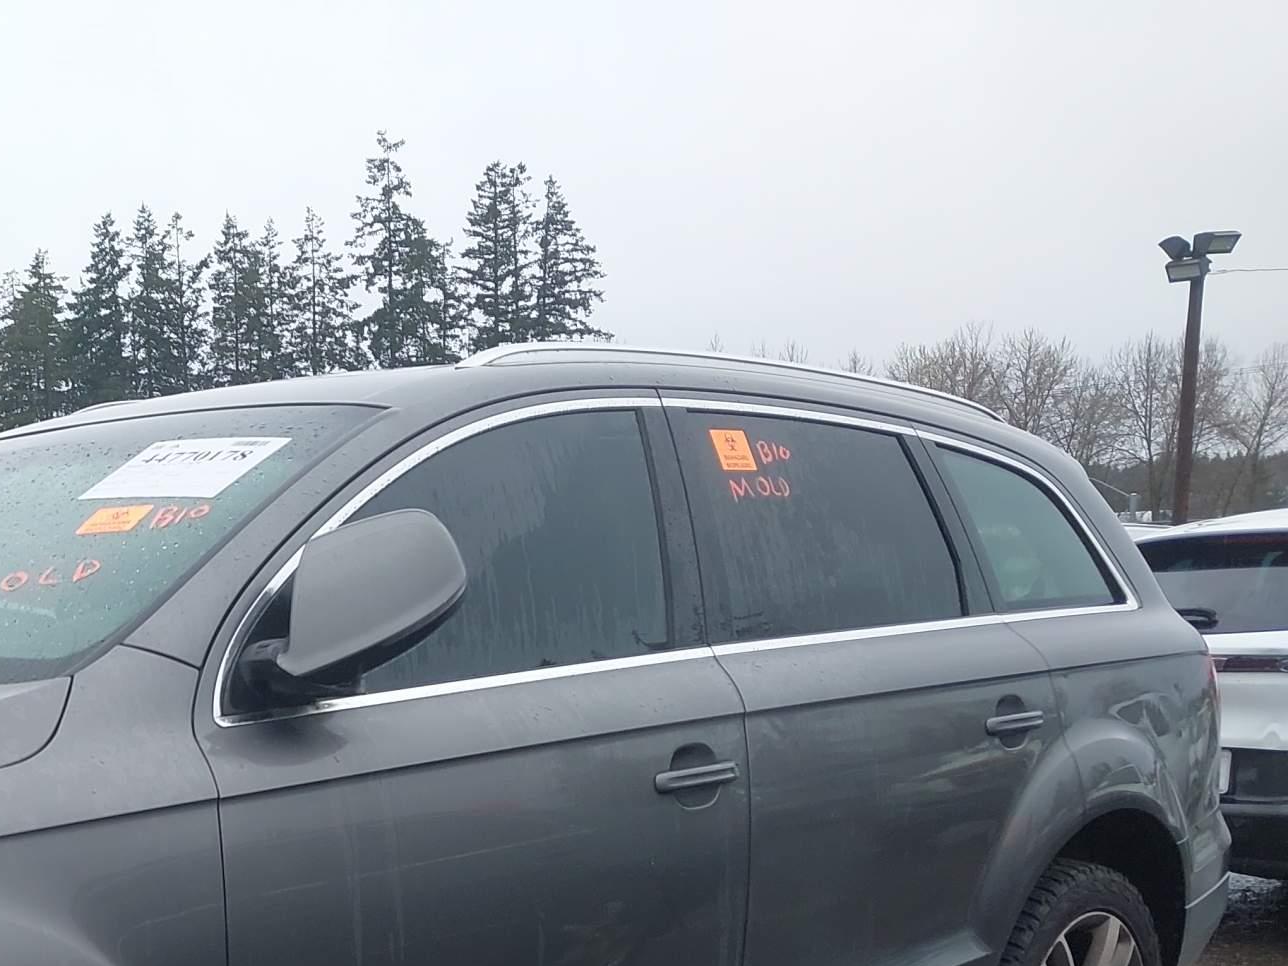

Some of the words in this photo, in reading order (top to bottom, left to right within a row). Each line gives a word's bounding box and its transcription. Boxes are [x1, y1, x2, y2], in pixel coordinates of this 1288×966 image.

[142, 450, 253, 463] 44770178
[729, 476, 791, 502] MOLD
[150, 504, 211, 529] BIO
